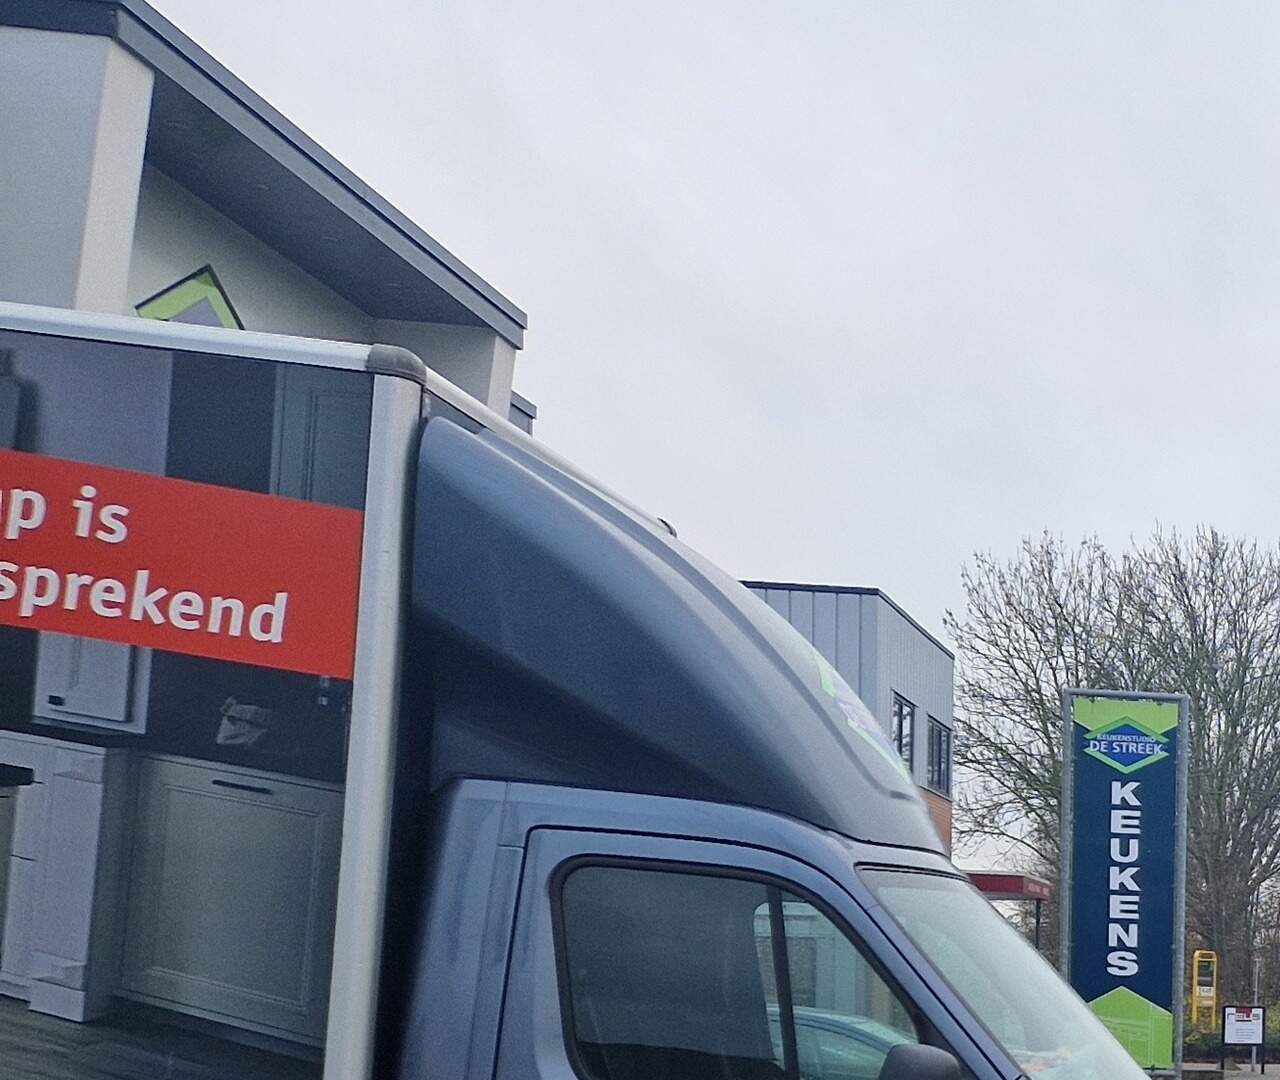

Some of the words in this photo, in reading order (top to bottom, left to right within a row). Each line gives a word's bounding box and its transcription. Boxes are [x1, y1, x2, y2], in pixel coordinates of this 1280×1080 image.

[0, 487, 47, 540] p
[72, 485, 130, 544] is
[0, 560, 289, 644] sprekend
[1089, 740, 1109, 753] DE
[1112, 741, 1165, 755] STREEK
[1106, 781, 1142, 976] KEUKENS
